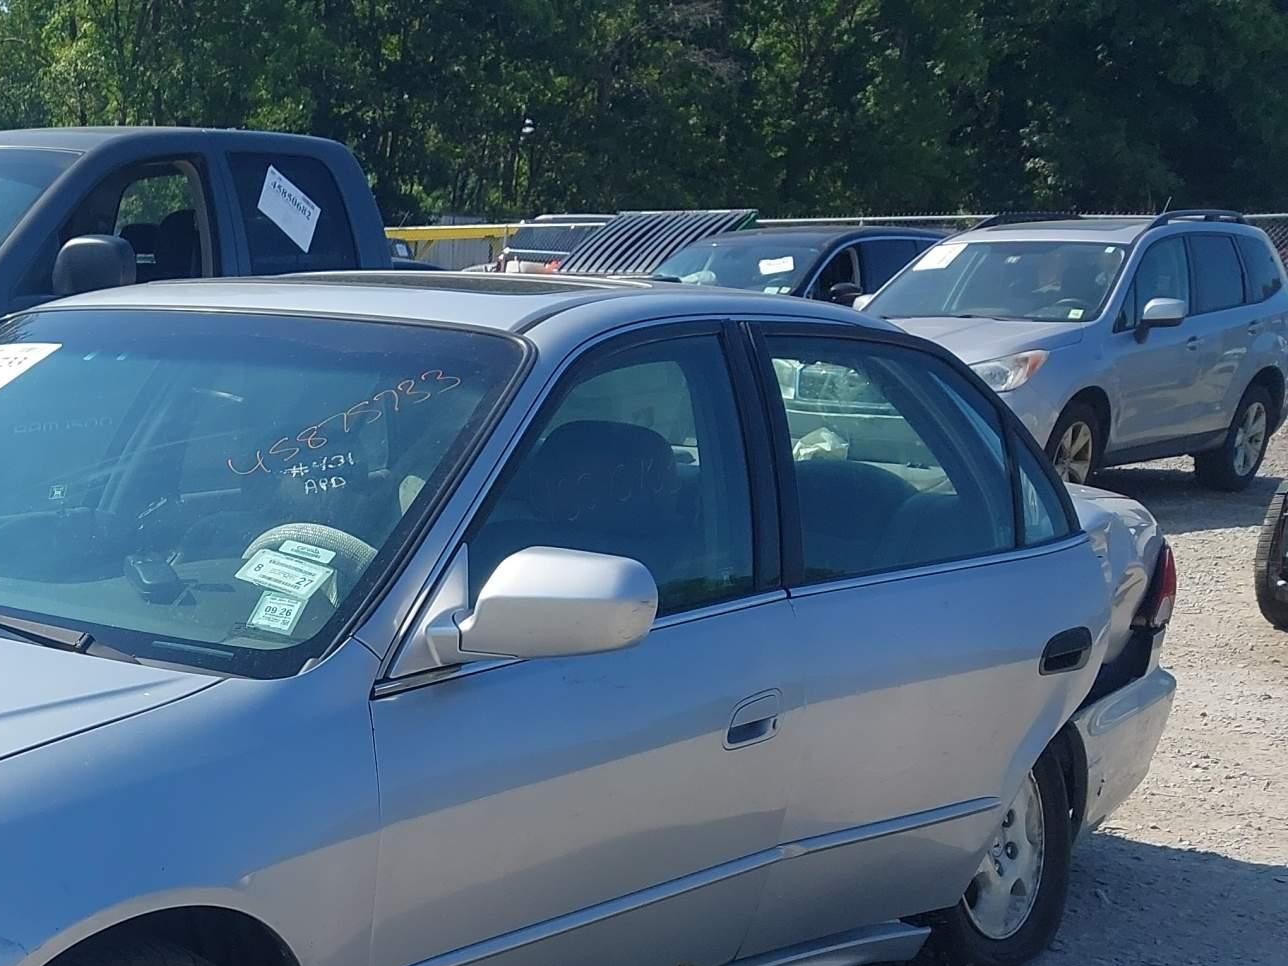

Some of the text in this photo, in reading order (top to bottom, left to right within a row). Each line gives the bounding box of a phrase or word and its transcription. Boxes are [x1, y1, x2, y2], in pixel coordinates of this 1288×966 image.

[253, 563, 264, 572] 8
[295, 577, 314, 588] 27
[264, 605, 293, 617] 09 26
